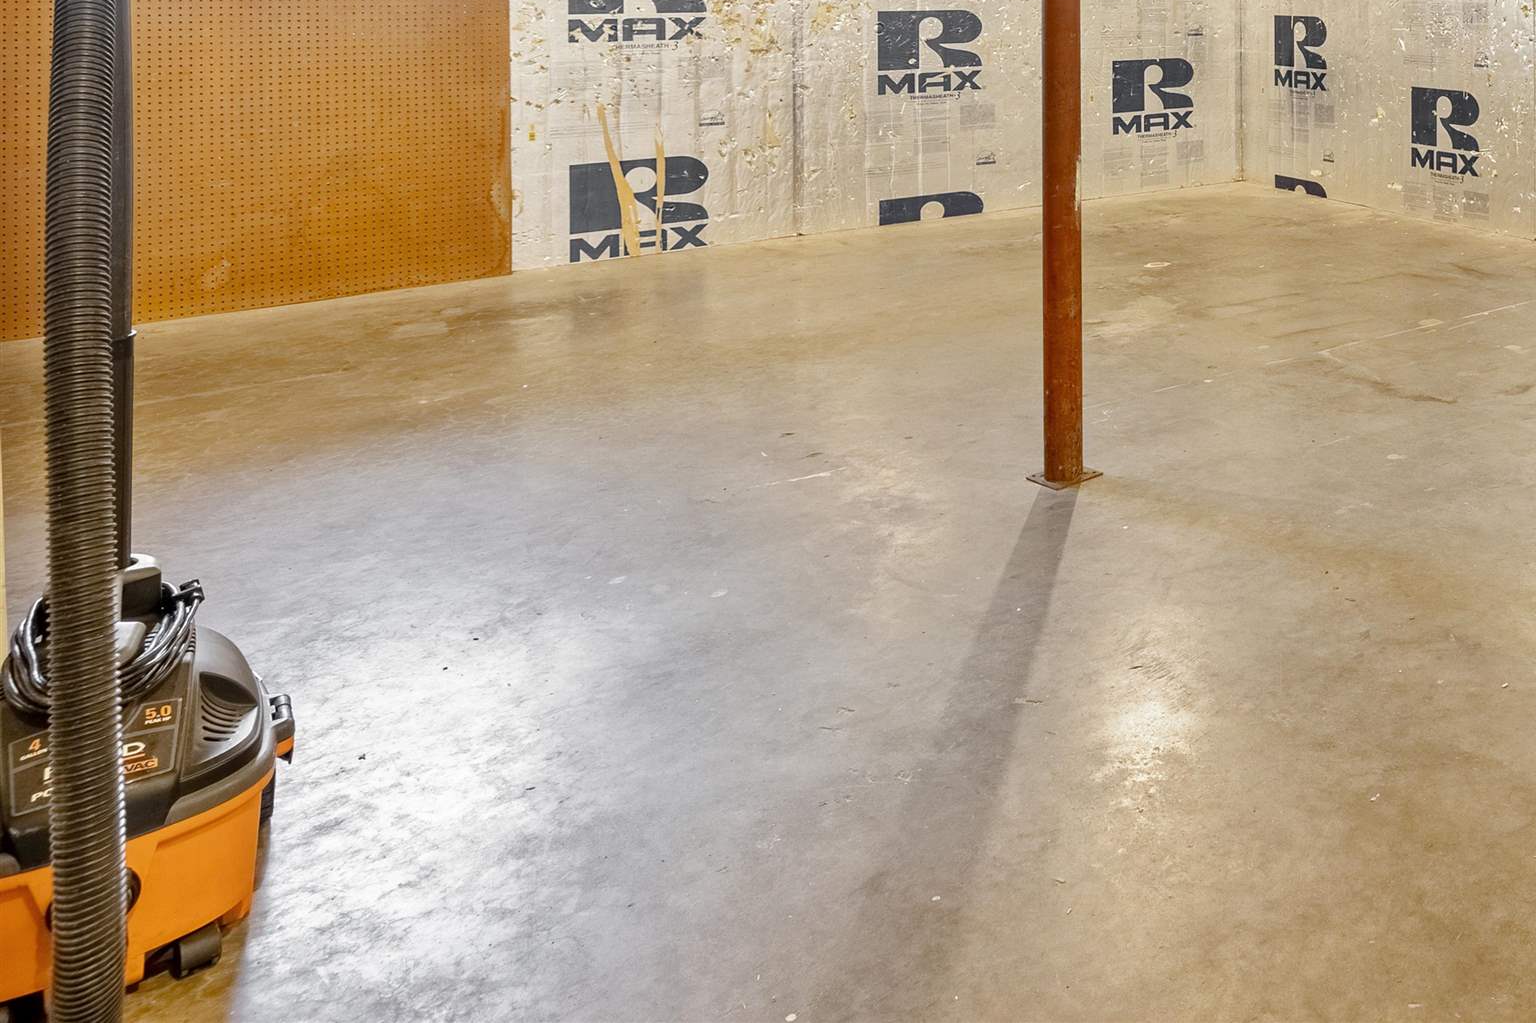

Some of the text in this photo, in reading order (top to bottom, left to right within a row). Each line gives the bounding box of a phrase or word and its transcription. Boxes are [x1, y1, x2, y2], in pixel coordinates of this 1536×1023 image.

[568, 17, 706, 43] MAX
[878, 10, 983, 71] R
[1274, 15, 1327, 69] R
[878, 70, 983, 95] MAX
[1112, 58, 1194, 113] R
[1274, 68, 1327, 91] MAX
[1112, 111, 1194, 135] MAX
[1411, 87, 1480, 152] R
[1411, 147, 1480, 176] MAX
[569, 156, 709, 234] R
[145, 704, 172, 720] 5.0
[28, 738, 42, 752] 4
